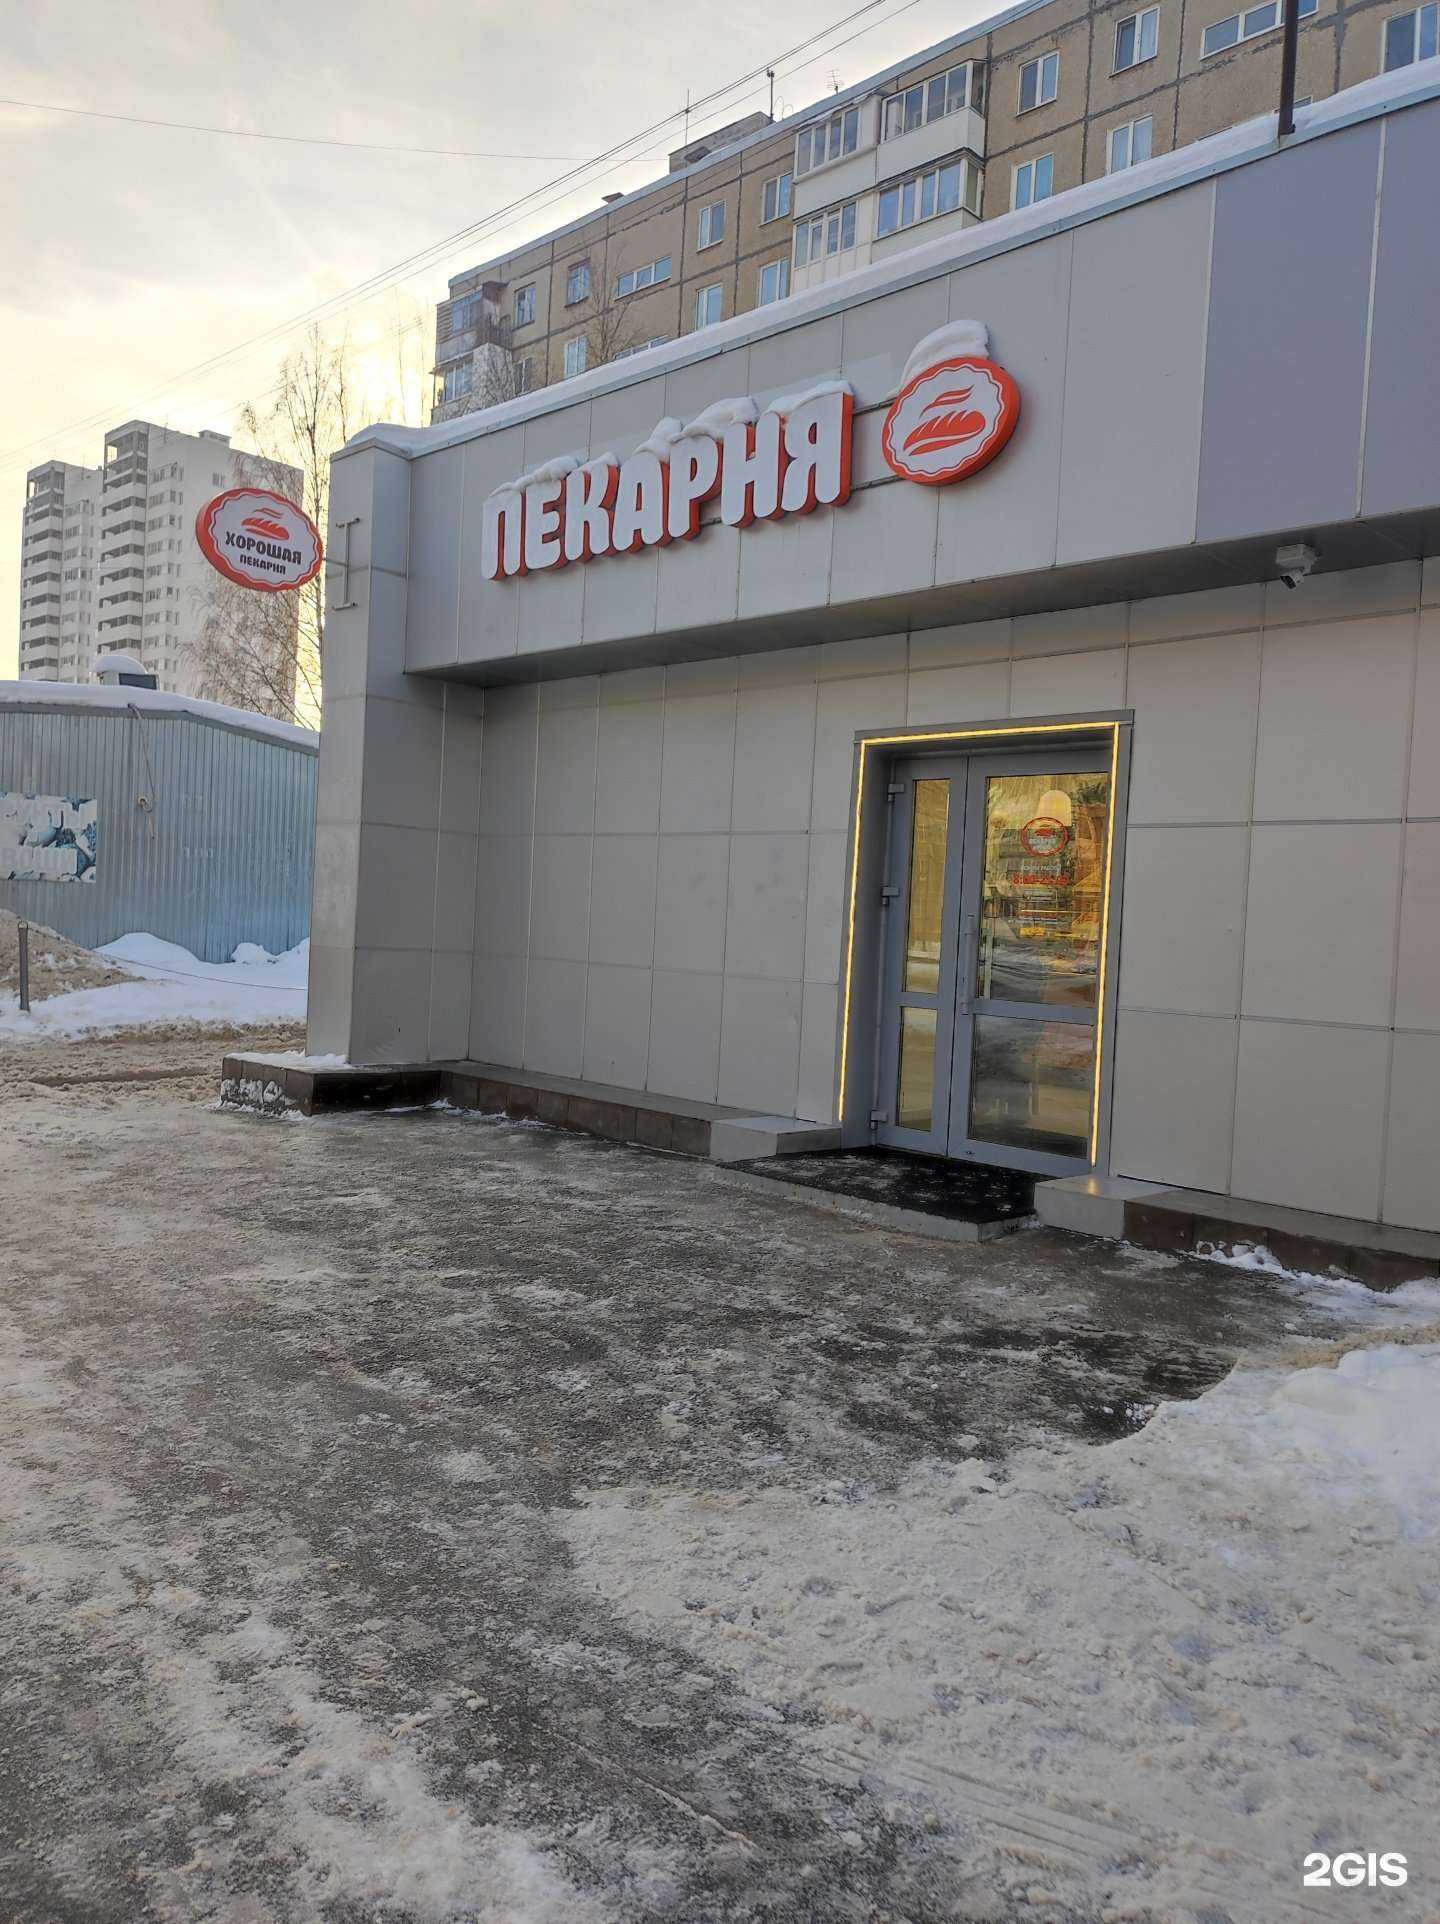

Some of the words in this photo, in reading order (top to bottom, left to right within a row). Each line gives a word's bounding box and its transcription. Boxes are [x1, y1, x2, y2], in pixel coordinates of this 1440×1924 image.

[481, 391, 853, 580] ПЕКАРНЯ
[225, 531, 302, 565] ХОРОШАЯ
[240, 554, 286, 575] ПЕКАРНЯ
